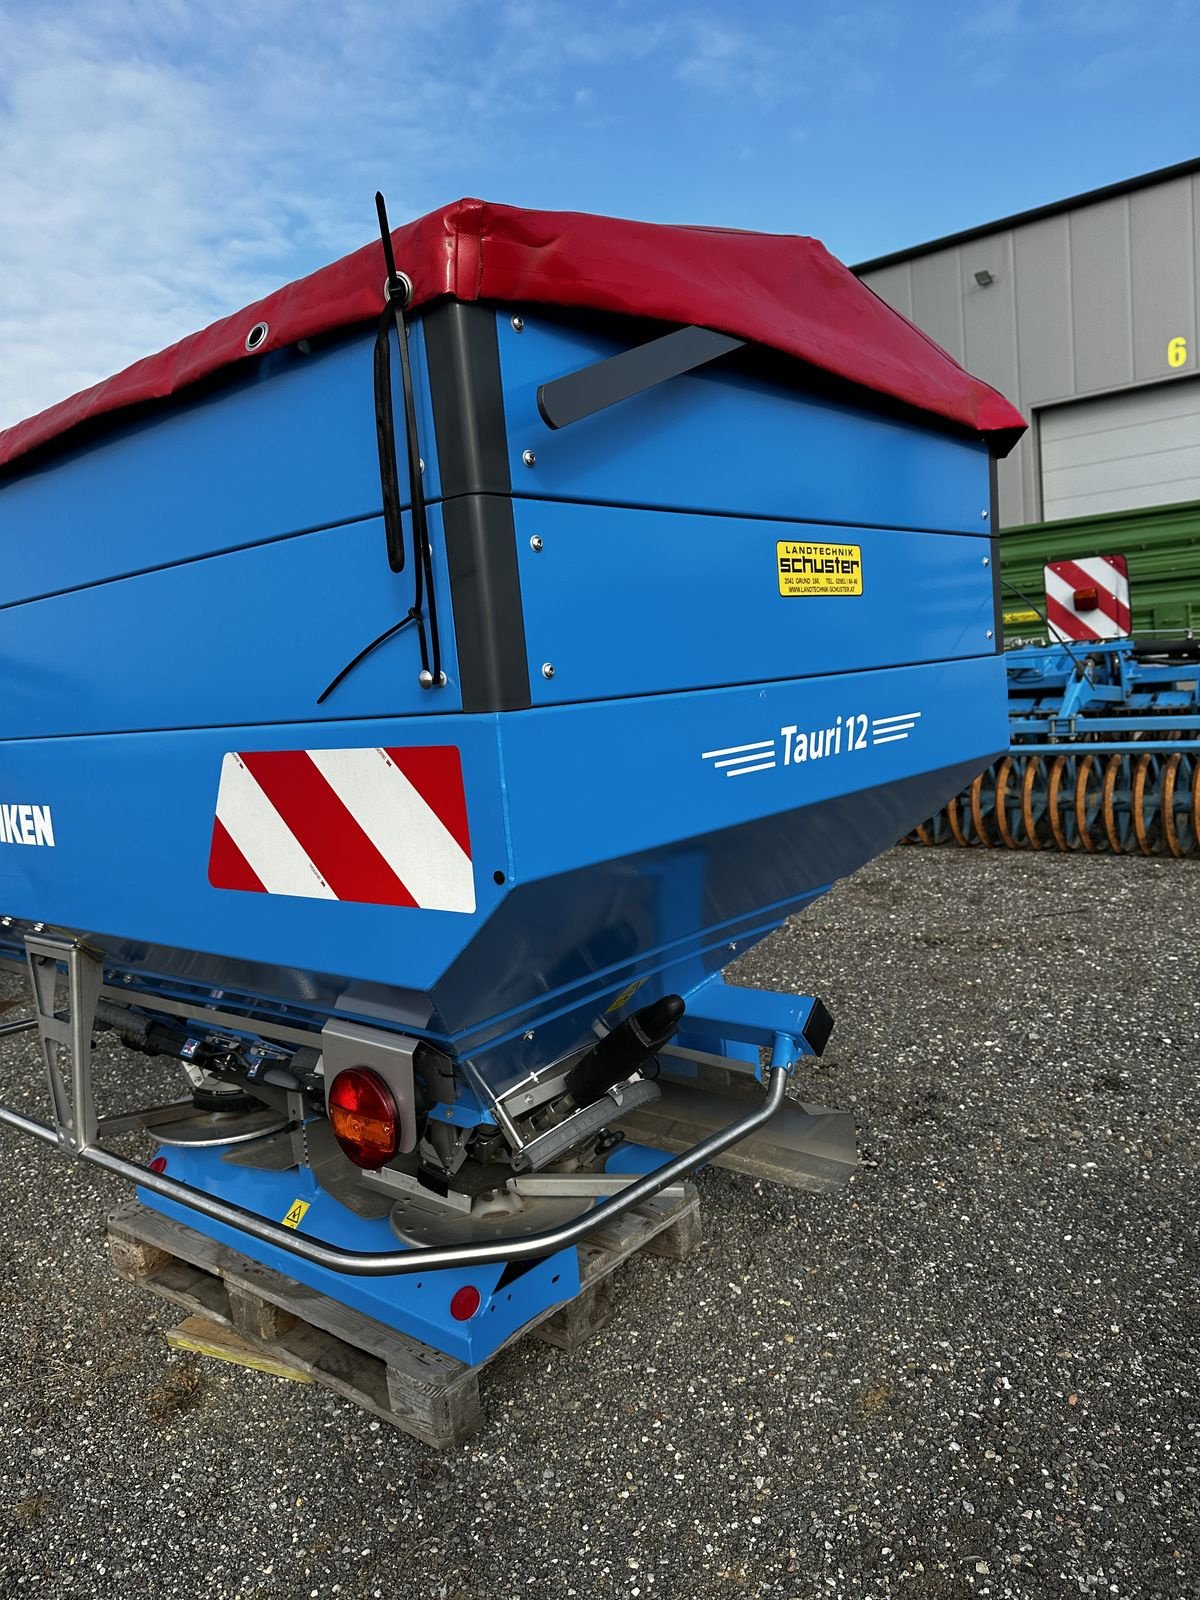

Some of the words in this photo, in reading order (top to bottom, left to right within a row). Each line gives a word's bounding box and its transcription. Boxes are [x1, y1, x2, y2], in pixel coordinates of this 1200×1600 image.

[1167, 336, 1187, 368] 6
[785, 546, 854, 556] LANDTECHNIK
[780, 556, 860, 574] schuster
[781, 715, 843, 766] Tauri
[846, 713, 869, 752] 12
